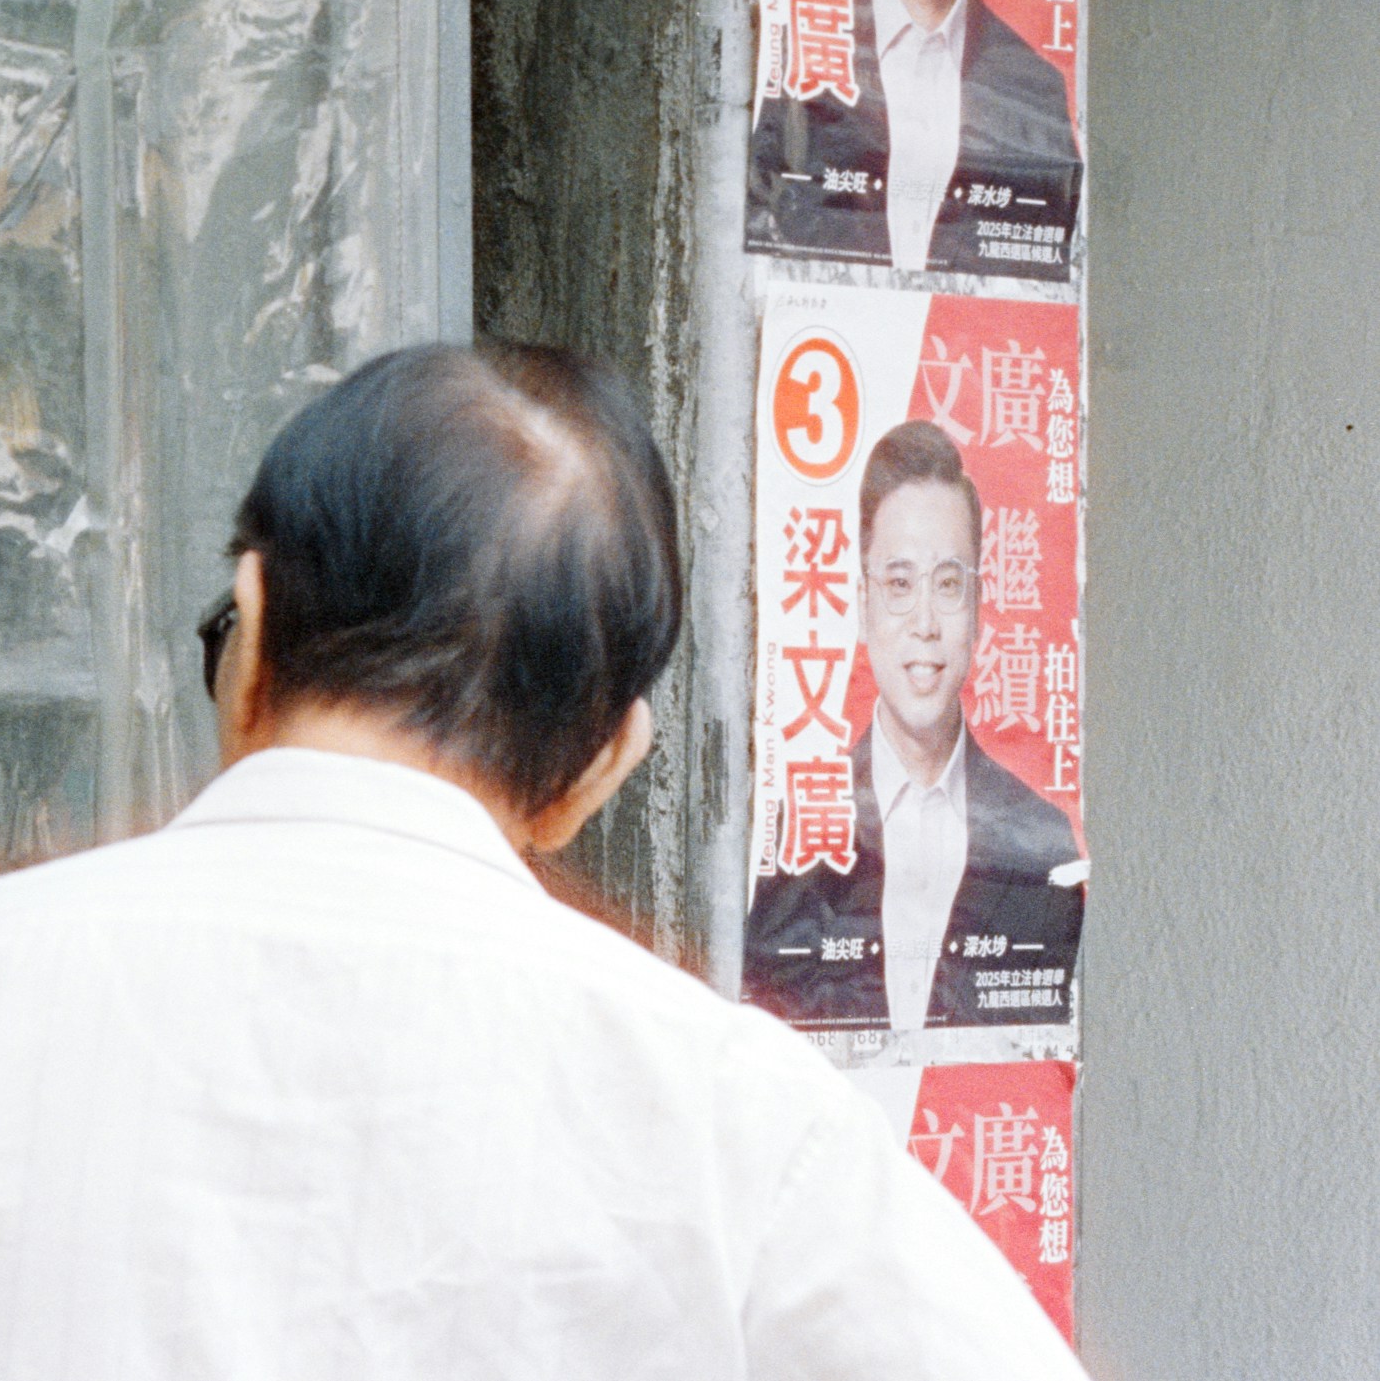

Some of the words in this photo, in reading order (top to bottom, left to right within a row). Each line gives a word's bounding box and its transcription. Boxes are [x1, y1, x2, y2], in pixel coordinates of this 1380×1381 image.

[765, 23, 782, 97] Leung
[822, 168, 869, 193] 油尖旺
[784, 348, 846, 466] 3
[919, 335, 1046, 451] 文廣
[1046, 368, 1074, 504] 為您想
[971, 506, 1043, 733] 繼續
[762, 641, 777, 726] Kwong
[780, 505, 852, 869] 梁文廣
[1043, 643, 1077, 792] 拍住上
[762, 738, 775, 788] Man
[760, 799, 777, 875] Leung
[821, 937, 865, 960] 油尖旺
[1039, 1126, 1069, 1265] 為您想
